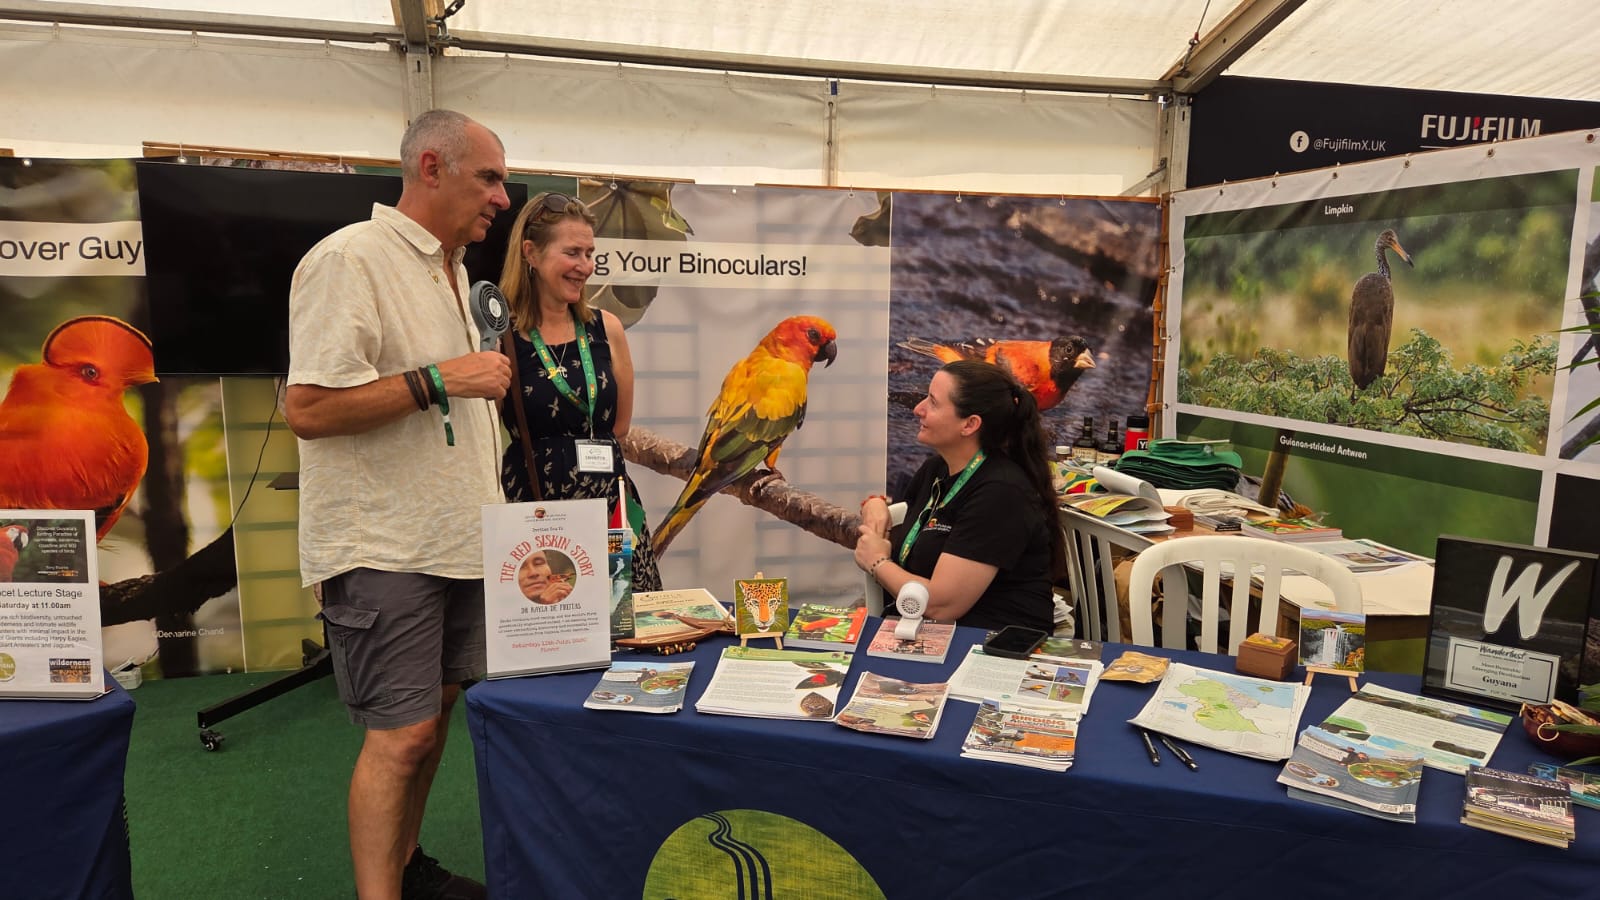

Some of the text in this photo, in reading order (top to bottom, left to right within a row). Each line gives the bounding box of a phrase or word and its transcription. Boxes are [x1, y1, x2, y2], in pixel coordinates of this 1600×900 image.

[1313, 138, 1386, 152] @FujifilmX.UK
[1324, 204, 1354, 217] Limpkin
[0, 236, 142, 265] over Guy
[616, 250, 671, 273] Your
[679, 252, 807, 276] Binoculars!
[500, 534, 595, 584] THE RED SISKIN STORY
[18, 589, 52, 597] Lecture
[55, 589, 83, 599] Stage
[1483, 555, 1581, 640] W
[1482, 675, 1518, 689] Guyana
